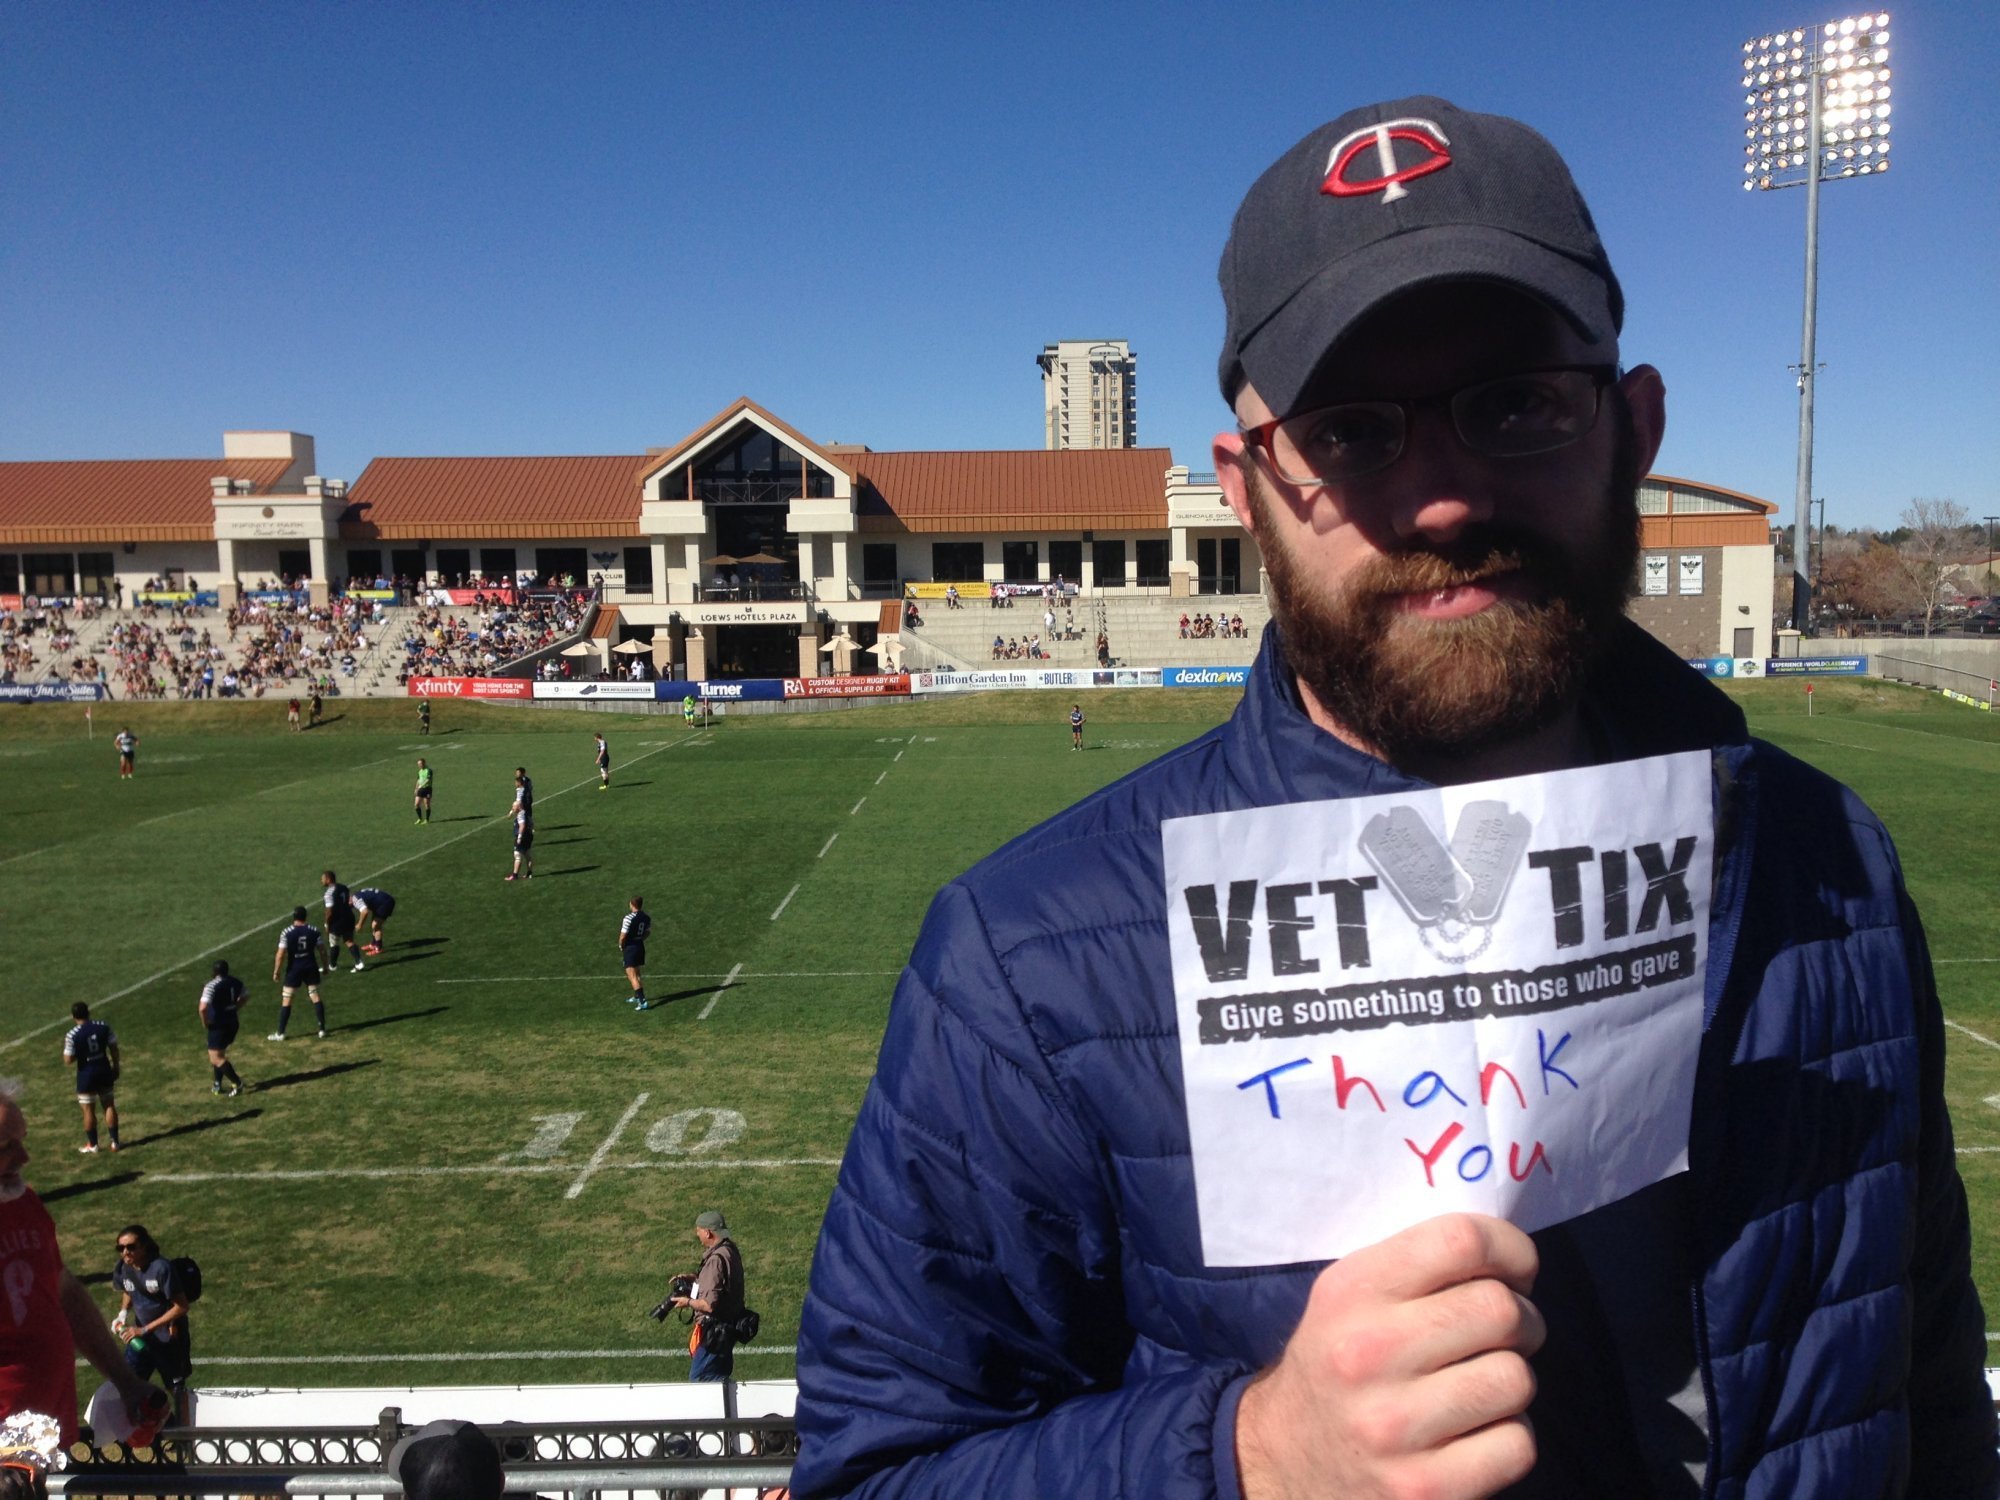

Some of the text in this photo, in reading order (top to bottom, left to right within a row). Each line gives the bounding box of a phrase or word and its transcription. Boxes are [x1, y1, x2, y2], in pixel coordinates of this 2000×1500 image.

[935, 673, 1026, 685] Hilton Garden Inn
[1044, 672, 1072, 684] BUTLER
[1175, 669, 1244, 683] dexknows
[0, 685, 29, 697] ampton
[416, 679, 463, 695] xfinity
[697, 682, 742, 695] Turner
[783, 680, 804, 694] RA
[815, 686, 842, 694] OFFICIAL
[844, 685, 874, 693] SUPPLIER
[1184, 875, 1379, 983] VET
[1529, 836, 1698, 949] TIX
[1220, 949, 1680, 1031] Give something to those who gave
